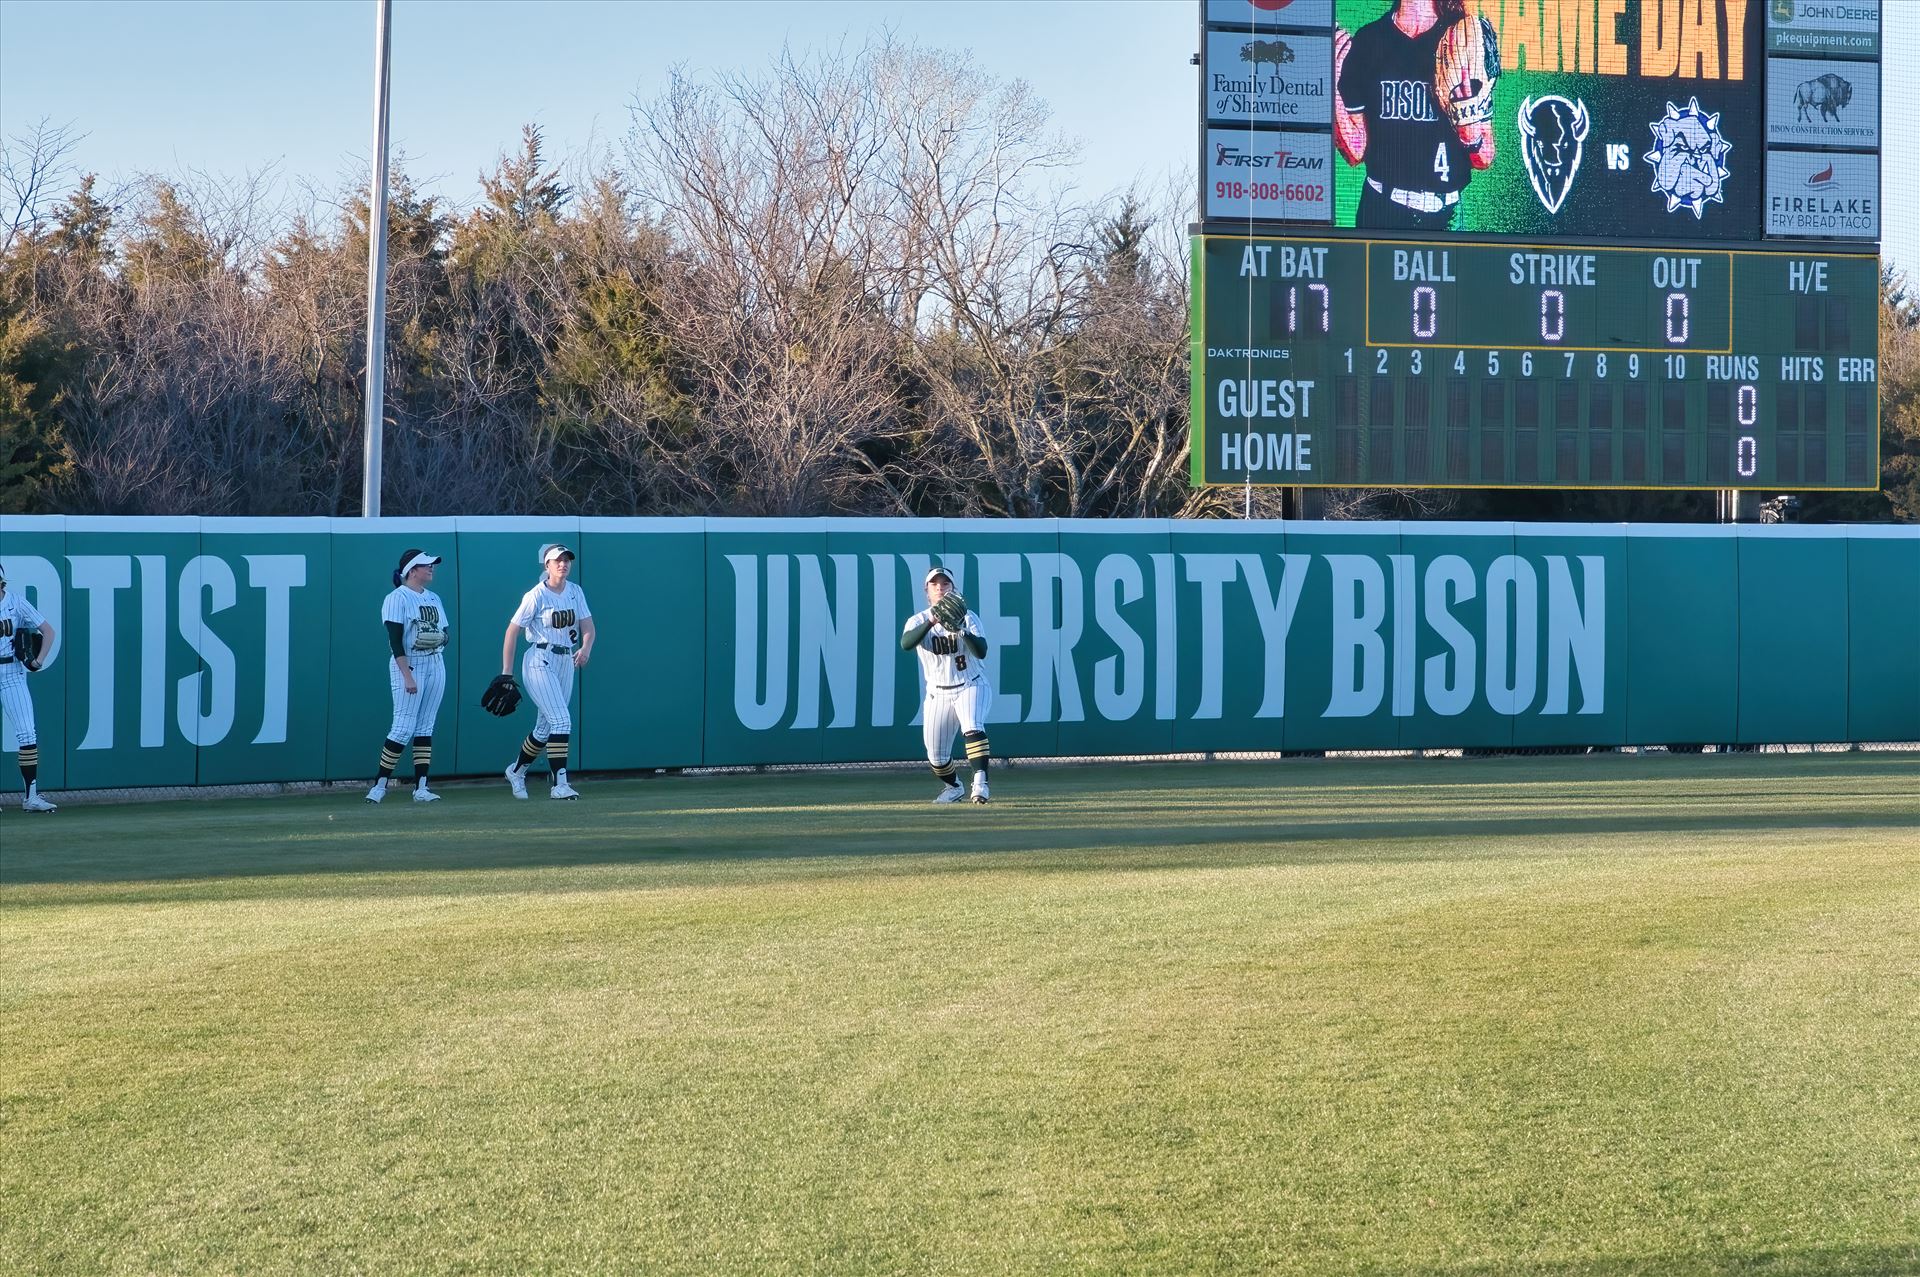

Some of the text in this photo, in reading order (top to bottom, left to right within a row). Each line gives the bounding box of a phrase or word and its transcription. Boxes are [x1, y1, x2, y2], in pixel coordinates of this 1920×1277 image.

[1798, 4, 1878, 20] JOHN DEERE
[1478, 0, 1627, 75] AME
[1776, 32, 1872, 48] pkequipment.com
[1212, 74, 1324, 97] Family Dental
[1216, 94, 1298, 114] of Shawnee
[1770, 124, 1874, 136] BISON CONSTRUCTION SERVICES
[1216, 147, 1323, 170] FIRST TEAM
[1434, 142, 1450, 182] 4
[1606, 144, 1630, 170] VS
[1216, 181, 1324, 202] 918-808-6602
[1772, 196, 1872, 214] FIRELAKE
[1772, 214, 1872, 229] FRY BREAD TACO
[1240, 245, 1329, 279] AT BAT
[1394, 250, 1456, 282] BALL
[1509, 252, 1596, 286] STRIKE
[1653, 257, 1702, 289] OUT
[1789, 261, 1828, 294] H/E
[1288, 283, 1329, 332] 17
[1413, 286, 1436, 338] 0
[1541, 289, 1564, 341] 0
[1666, 293, 1689, 343] 0
[1208, 348, 1290, 359] DAKTRONICS
[1344, 348, 1875, 382] 1 2 3 4 5 6 7 8 9 10 RUNS HITS ERR
[1218, 378, 1315, 419] GUEST
[1738, 385, 1756, 425] 0
[1221, 432, 1312, 471] HOME
[1737, 436, 1756, 476] 0
[419, 606, 440, 624] OBU
[552, 608, 576, 630] OBU
[568, 630, 578, 644] 2
[932, 634, 958, 655] OBU
[1321, 554, 1605, 719] BISON
[0, 554, 306, 752] PTIST
[955, 654, 967, 672] 8
